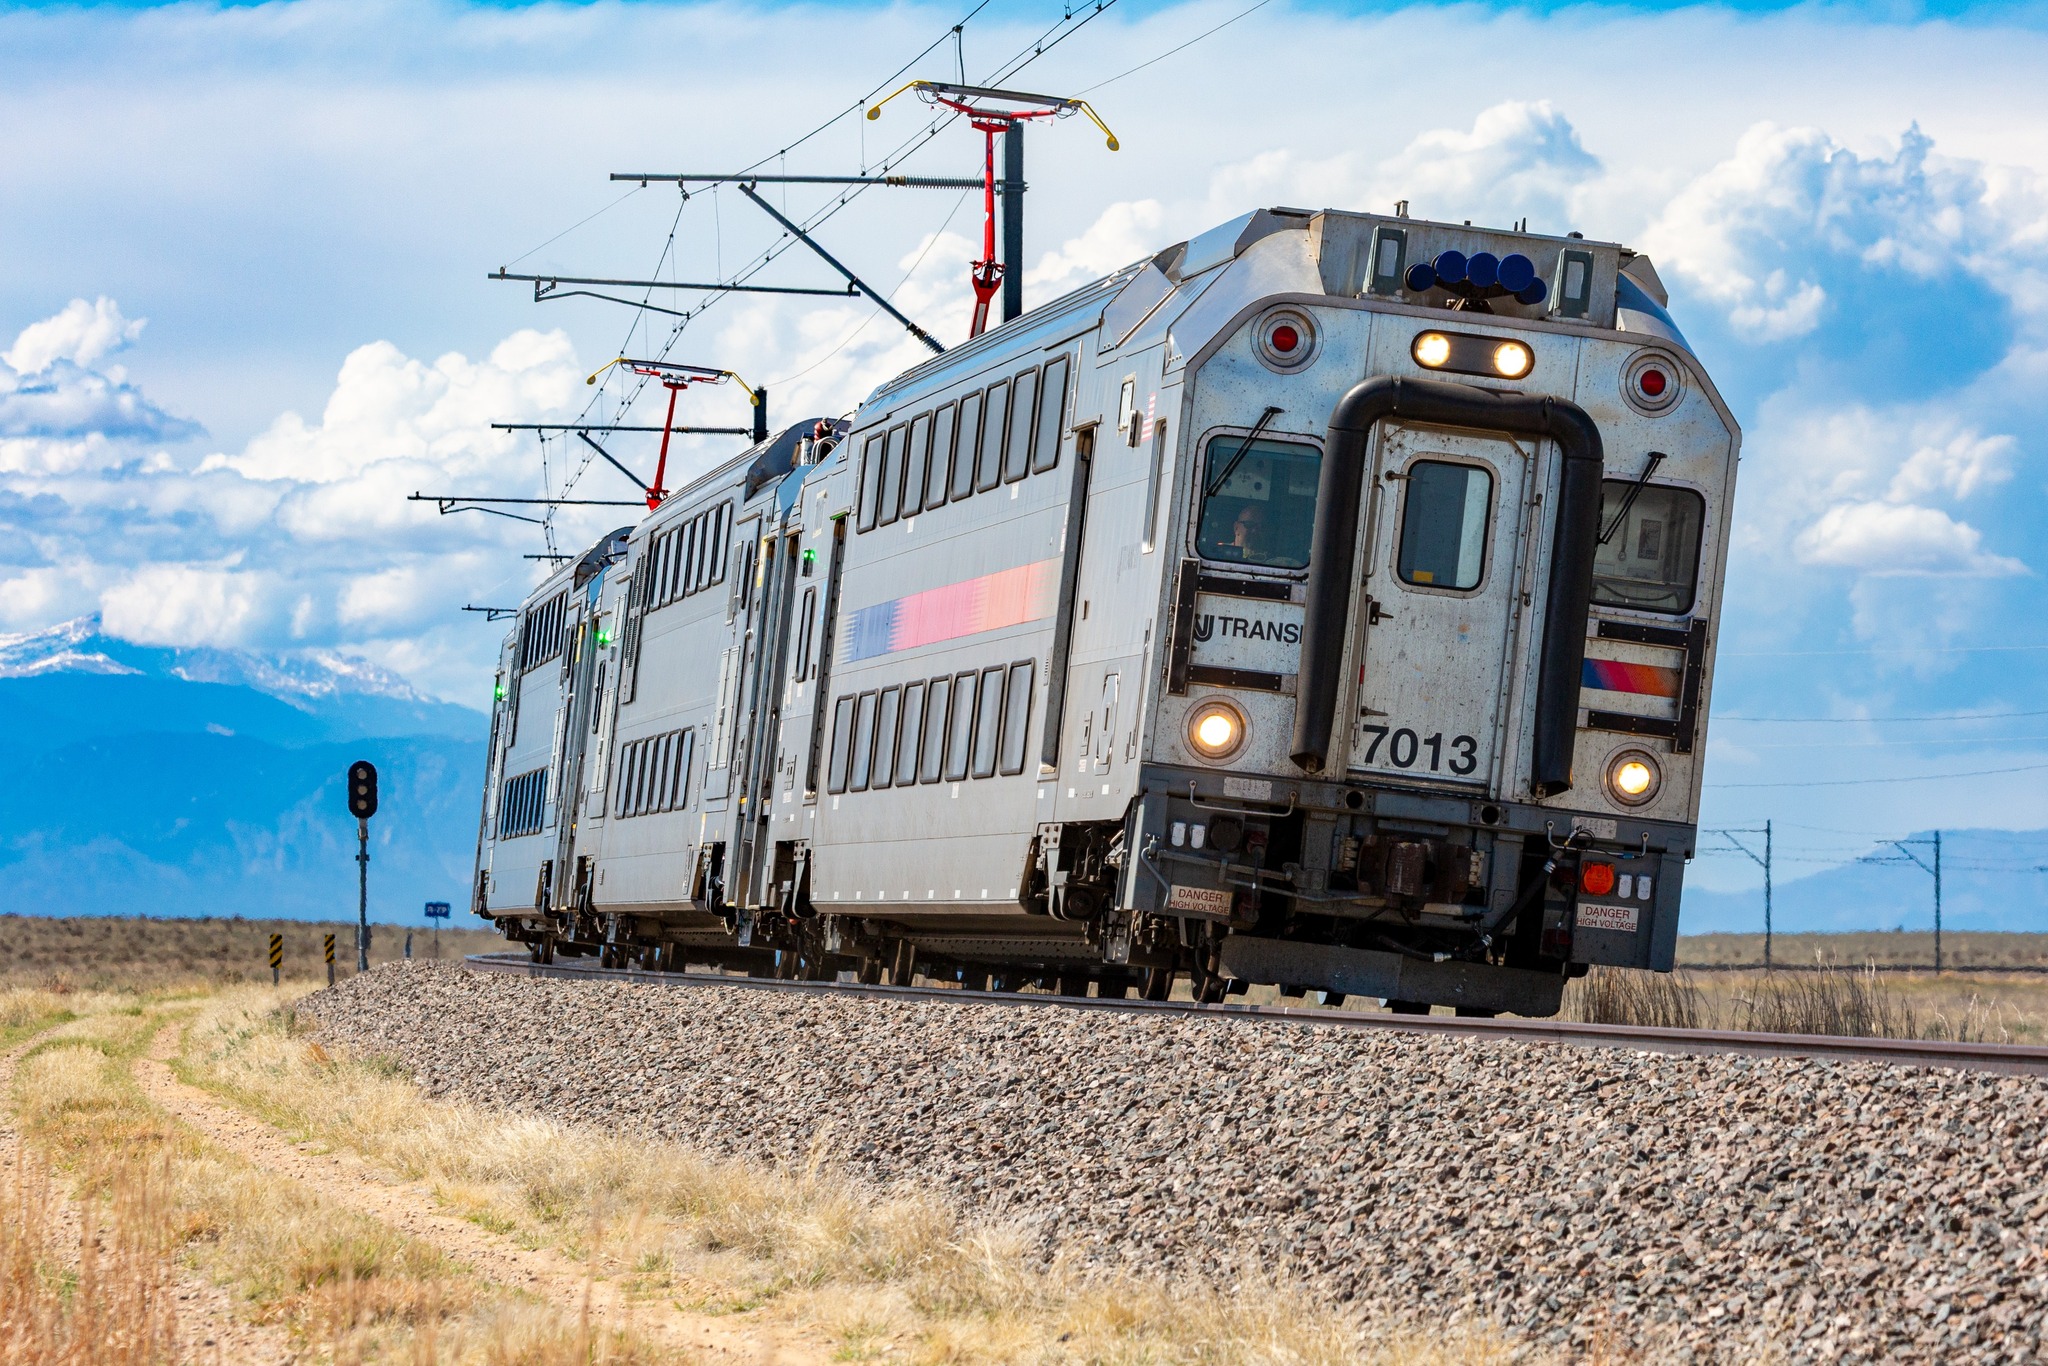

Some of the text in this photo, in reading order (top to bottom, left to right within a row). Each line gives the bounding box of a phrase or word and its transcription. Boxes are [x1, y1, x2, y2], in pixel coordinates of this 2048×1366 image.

[1363, 724, 1478, 775] 7013
[1179, 888, 1223, 903] DANGER
[1169, 899, 1229, 915] HIGH VOLTAGE
[1585, 906, 1630, 919] DANGER
[1576, 917, 1637, 931] HIGH VOLTAGE
